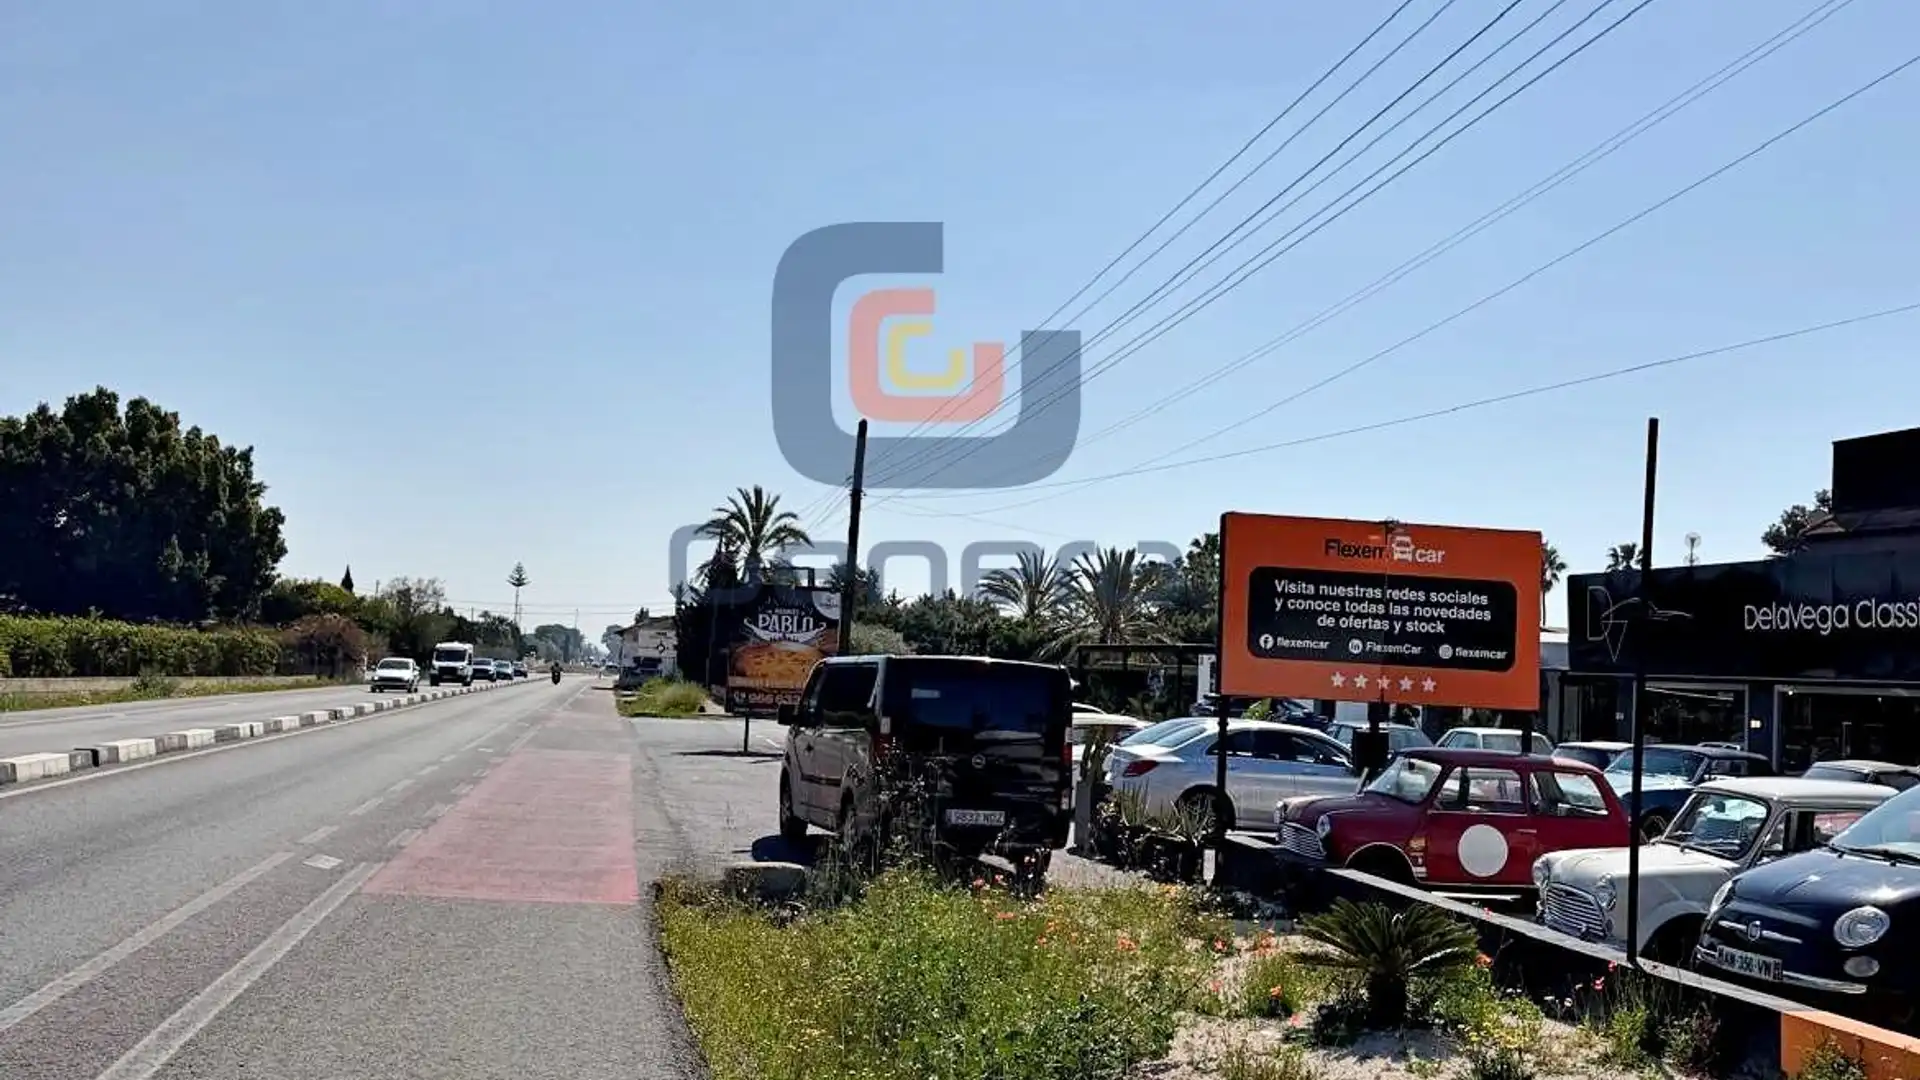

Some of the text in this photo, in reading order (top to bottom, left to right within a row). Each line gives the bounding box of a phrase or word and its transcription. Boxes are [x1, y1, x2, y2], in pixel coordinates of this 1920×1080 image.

[1415, 548, 1445, 564] car
[1274, 579, 1489, 605] Visita nuestras redes sociales
[1274, 600, 1492, 621] y conoce todas las novedades
[1743, 601, 1850, 636] DelaVega
[1317, 615, 1446, 635] de ofertas y stock
